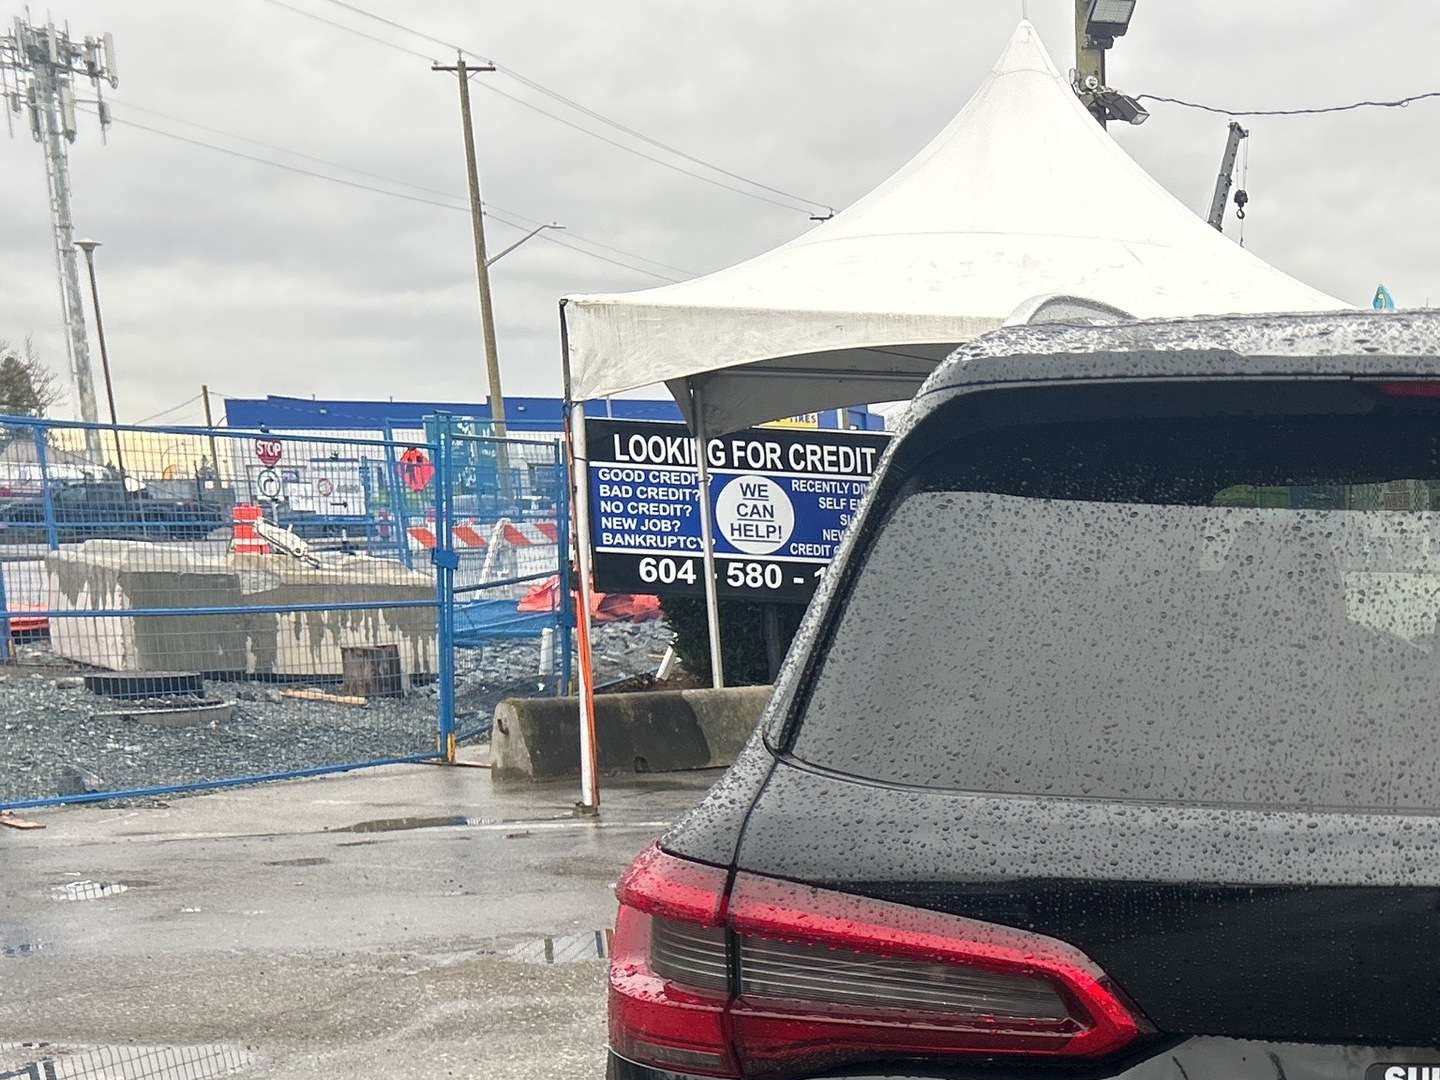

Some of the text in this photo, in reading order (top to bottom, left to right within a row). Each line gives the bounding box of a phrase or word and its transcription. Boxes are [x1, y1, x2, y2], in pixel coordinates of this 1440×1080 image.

[256, 440, 281, 456] STOP
[732, 440, 784, 470] FOR
[788, 444, 876, 474] CREDIT
[598, 468, 713, 486] GOOD CREDI?
[599, 485, 701, 501] BAD CREDIT?
[739, 482, 769, 498] WE
[791, 480, 850, 494] RECENTLY
[600, 501, 692, 517] NO CREDIT?
[736, 503, 775, 519] CAN
[818, 497, 860, 511] SELF E
[601, 517, 681, 532] NEW JOB?
[730, 522, 783, 540] HELP!
[790, 543, 831, 556] CREDIT
[638, 557, 697, 585] 604
[727, 561, 783, 589] 580
